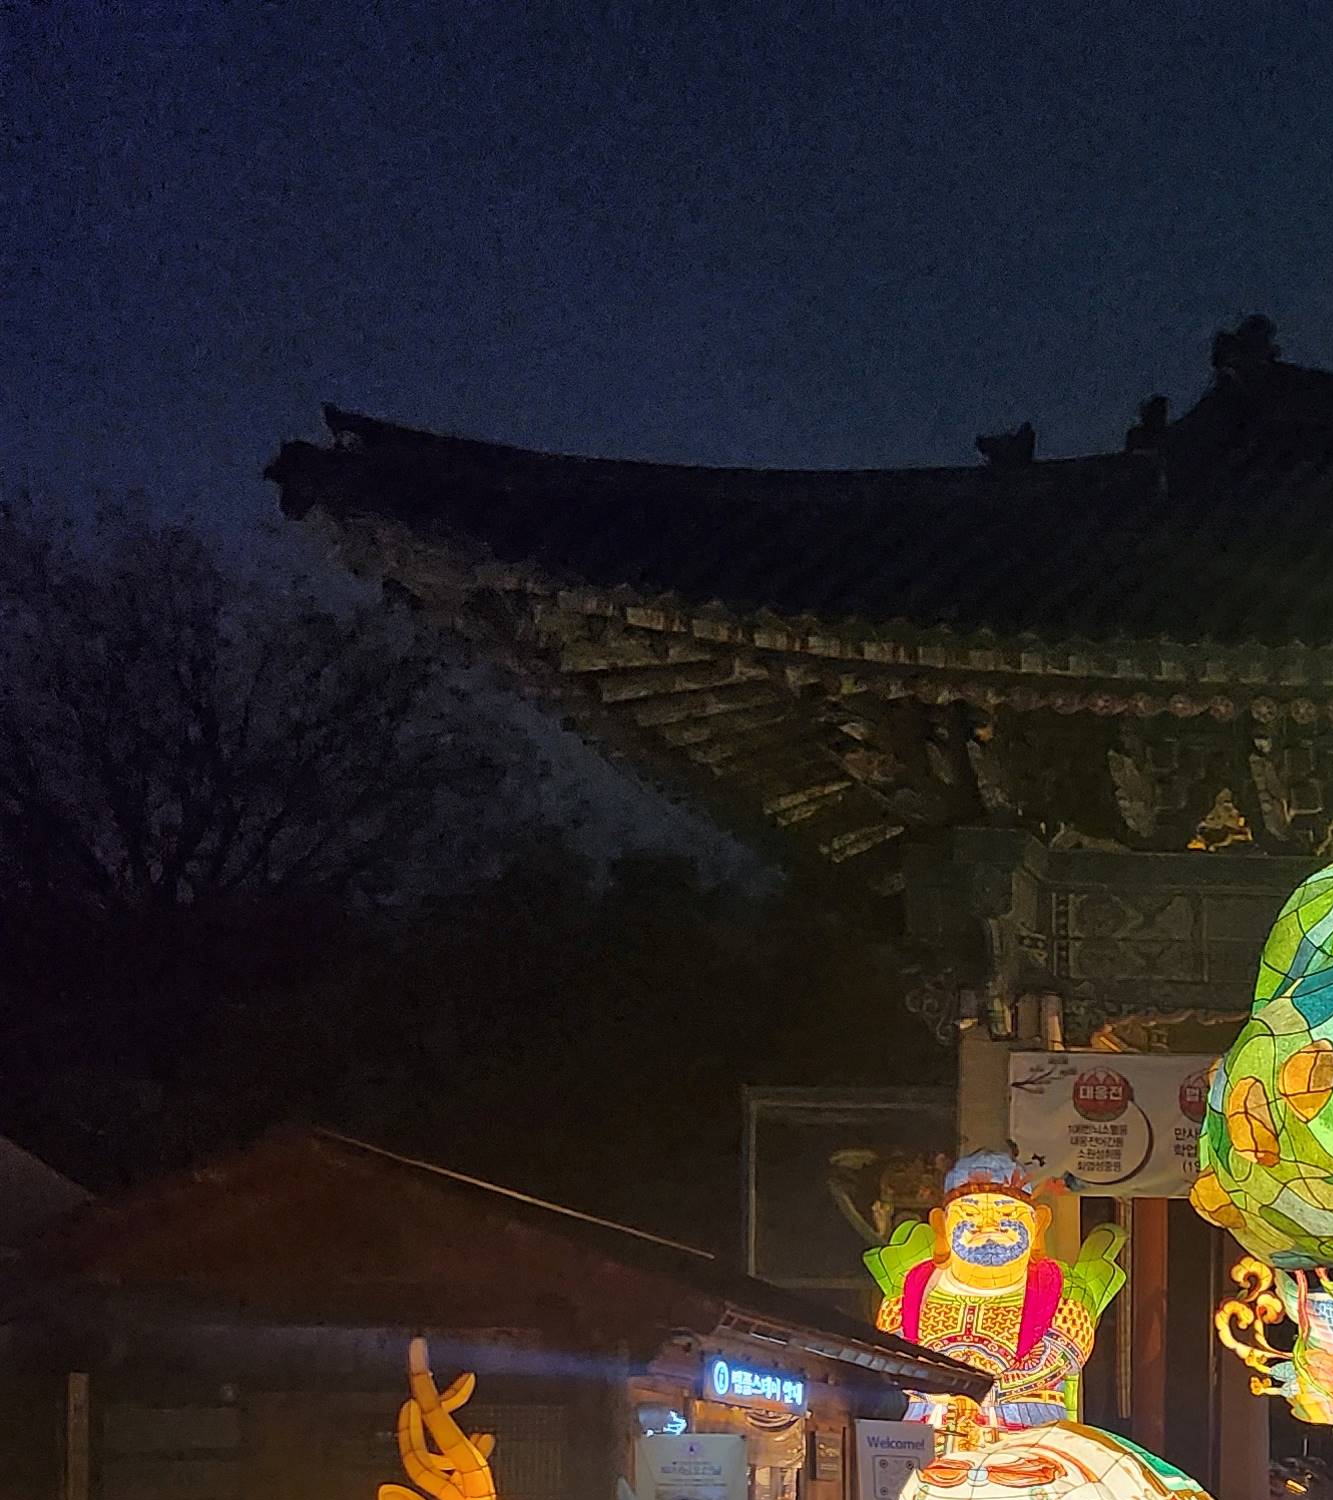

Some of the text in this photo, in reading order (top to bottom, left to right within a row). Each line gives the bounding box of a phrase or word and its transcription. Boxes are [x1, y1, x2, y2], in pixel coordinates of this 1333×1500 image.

[1079, 1085, 1123, 1100] 대웅전
[1174, 1127, 1201, 1142] 만사
[1173, 1144, 1200, 1158] 학업
[866, 1435, 926, 1451] Welcome!
